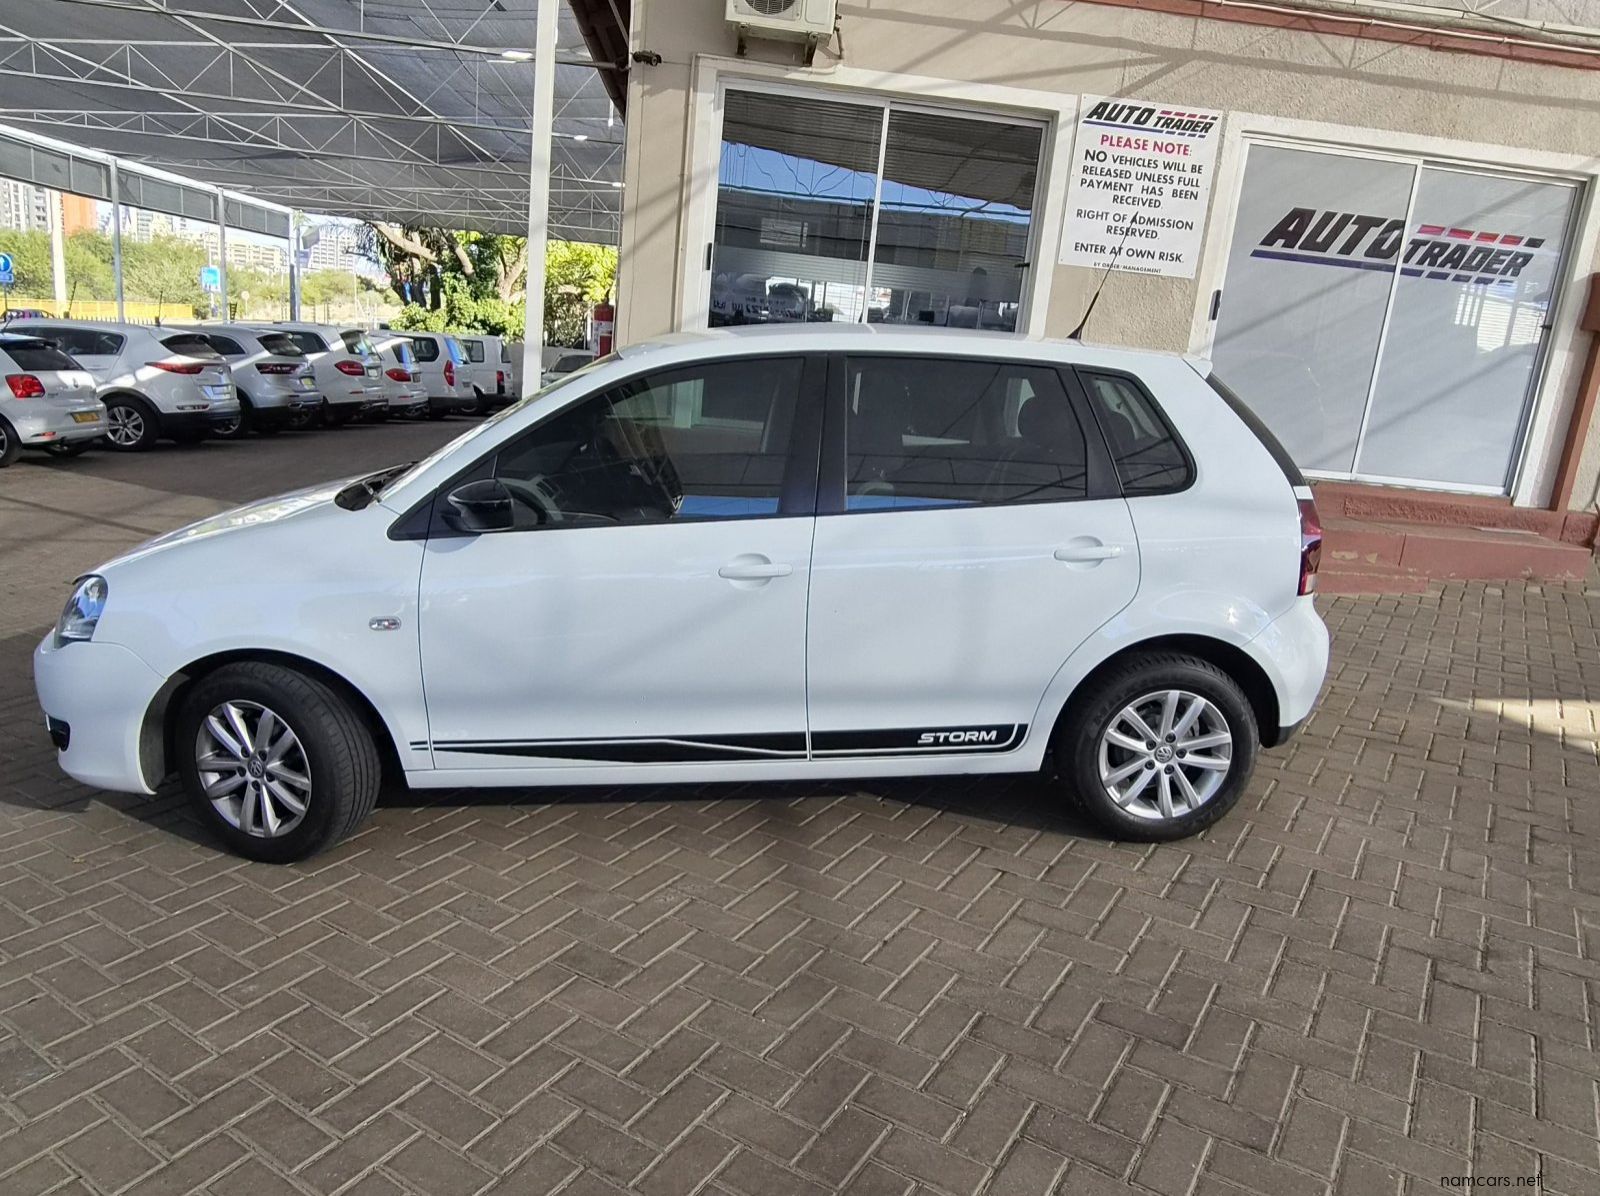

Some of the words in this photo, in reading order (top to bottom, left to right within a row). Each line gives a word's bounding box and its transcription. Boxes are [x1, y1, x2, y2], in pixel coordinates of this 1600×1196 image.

[1086, 101, 1157, 126] AUTO
[1153, 116, 1214, 133] TRADER
[1100, 134, 1149, 151] PLEASE
[1084, 149, 1107, 162] NO
[1112, 154, 1159, 169] VEHICLES
[1162, 160, 1187, 172] WILL
[1190, 164, 1203, 174] BE
[1082, 165, 1132, 179] RELEASED
[1135, 171, 1174, 185] UNLESS
[1177, 176, 1200, 188] FULL
[1080, 178, 1133, 193] PAYMENT
[1141, 185, 1164, 196] HAS
[1171, 189, 1199, 200] BEEN
[1076, 209, 1110, 221] RIGHT
[1112, 213, 1128, 223] OF
[1130, 215, 1194, 231] ADMISSION
[1074, 242, 1107, 254] ENTER
[1109, 246, 1124, 257] AT
[1126, 248, 1156, 260] OWN
[1258, 207, 1405, 260] AUTO
[1401, 238, 1534, 277] TRADER
[917, 730, 998, 744] STORM
